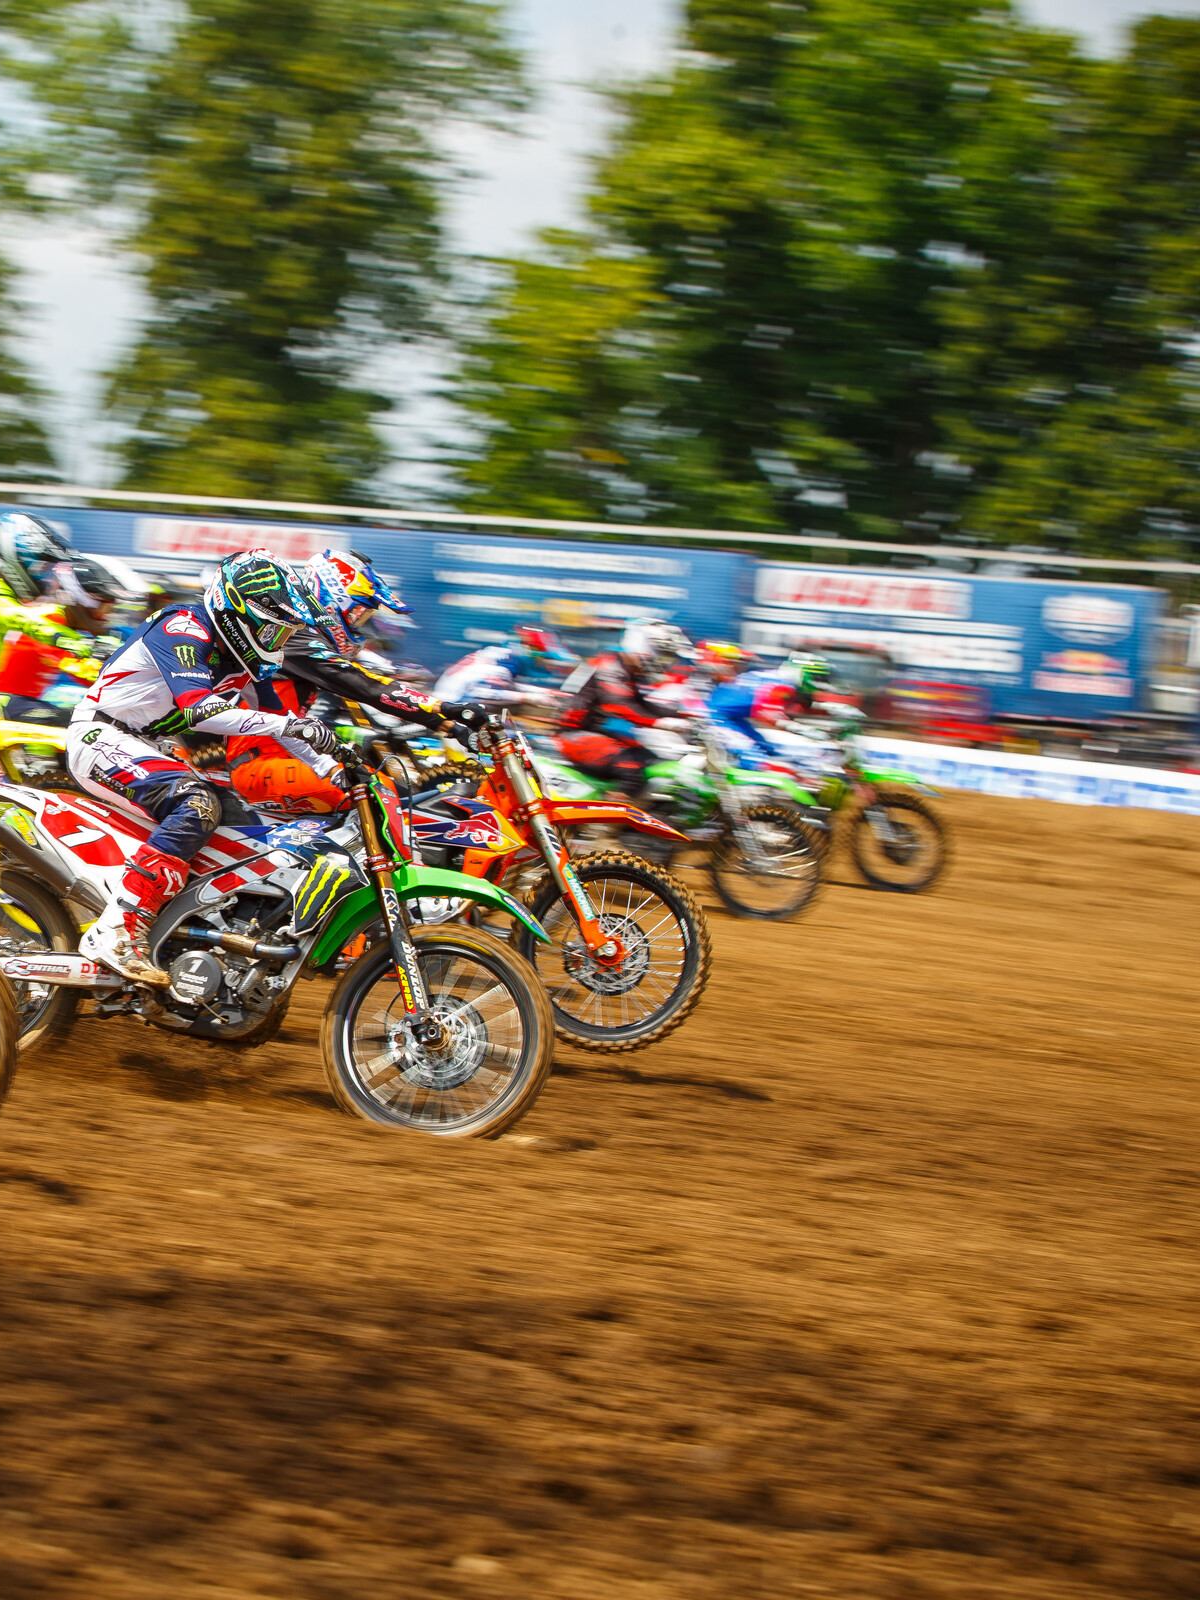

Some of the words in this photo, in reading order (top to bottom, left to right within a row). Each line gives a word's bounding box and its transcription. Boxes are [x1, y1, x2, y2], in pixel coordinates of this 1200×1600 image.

[57, 824, 108, 848] 1
[188, 959, 204, 973] 1
[401, 940, 426, 1010] DUNLOP
